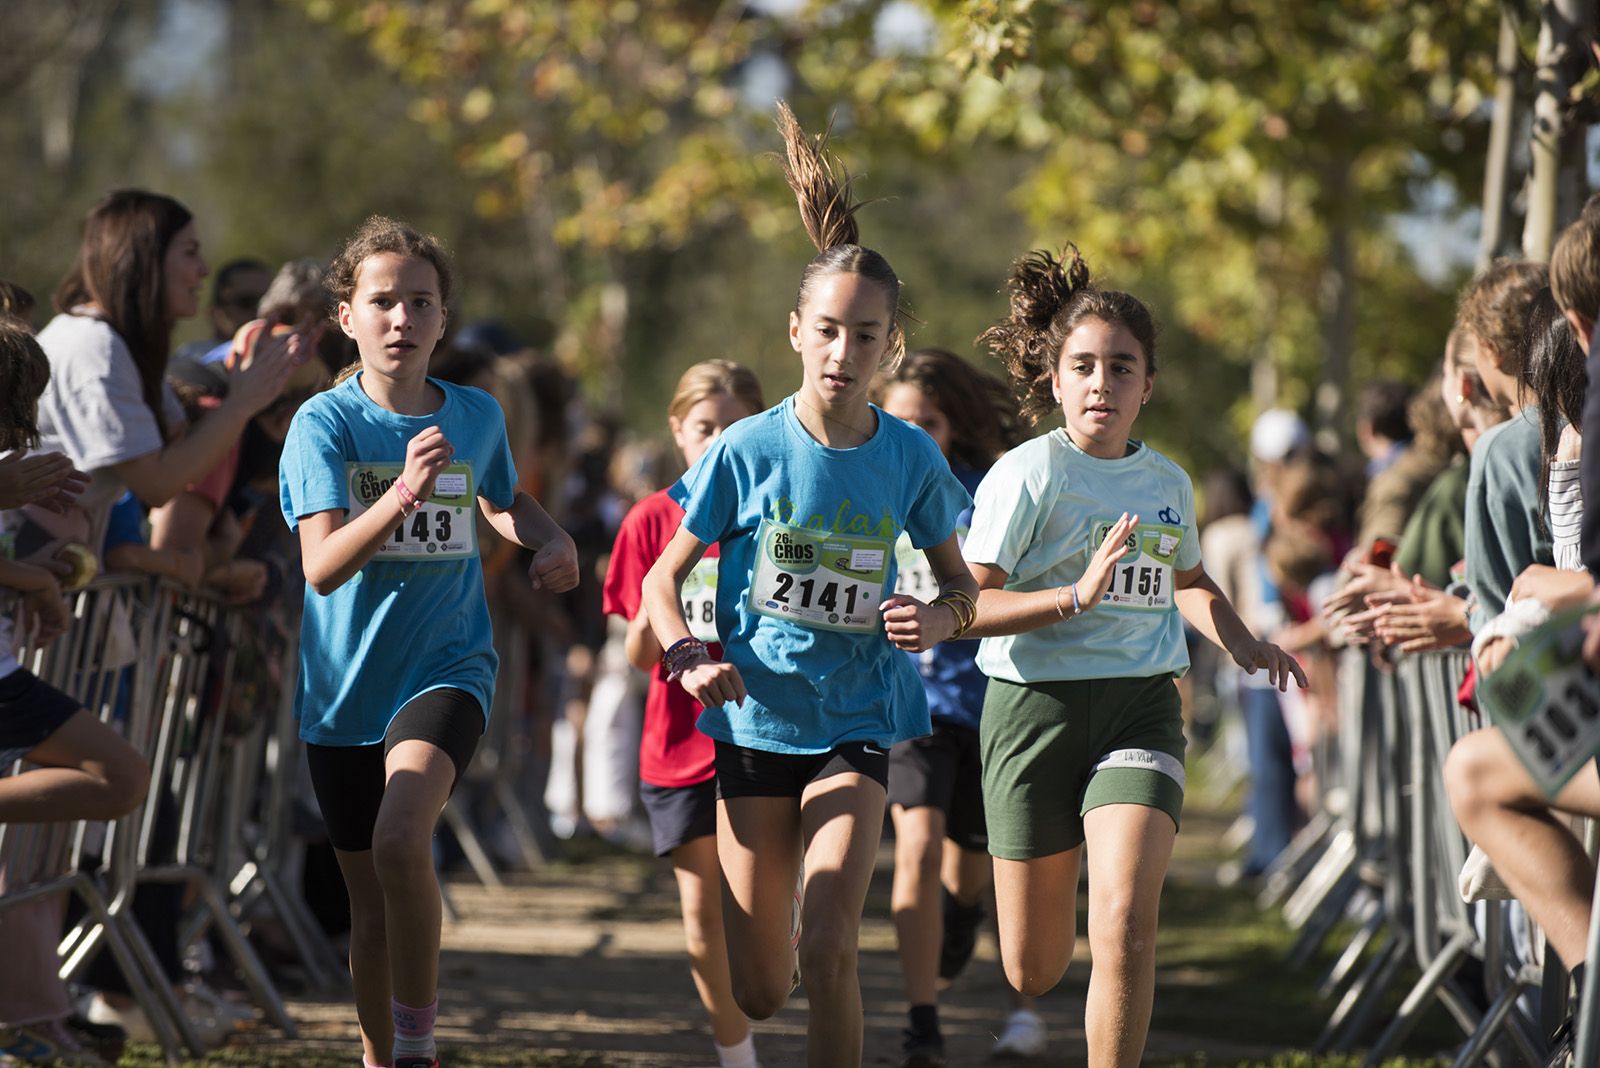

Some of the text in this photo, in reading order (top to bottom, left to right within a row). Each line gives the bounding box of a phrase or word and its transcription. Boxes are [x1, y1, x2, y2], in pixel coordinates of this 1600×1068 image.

[394, 510, 452, 543] 143
[774, 544, 814, 560] CROS
[772, 572, 859, 615] 2141
